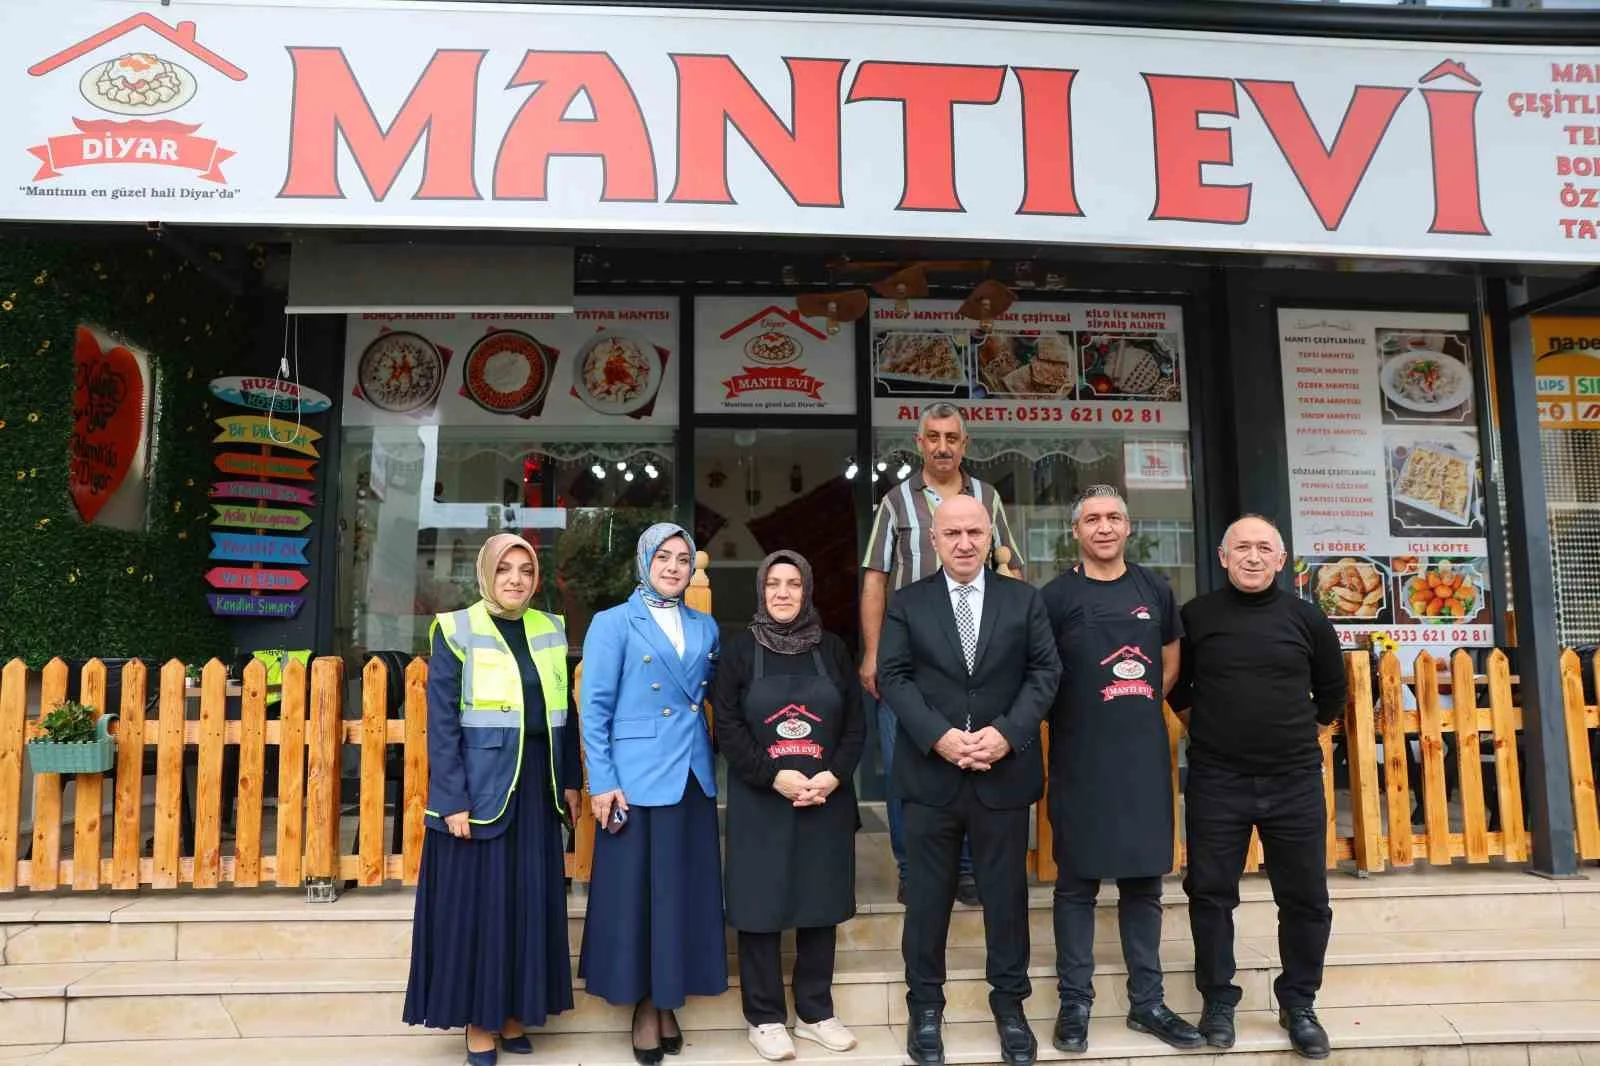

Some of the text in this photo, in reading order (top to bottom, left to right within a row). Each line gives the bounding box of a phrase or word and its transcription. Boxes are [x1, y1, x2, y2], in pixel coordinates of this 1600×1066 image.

[1508, 88, 1600, 118] ÇEŞİTL
[276, 46, 1086, 217] MANTI
[1563, 125, 1600, 145] TE
[82, 131, 180, 161] DİYAR
[91, 188, 107, 197] en
[111, 187, 147, 200] güzel
[150, 188, 175, 198] hali
[1559, 218, 1600, 240] TA
[574, 310, 669, 320] TATAR MANTISI
[1131, 311, 1166, 320] MANTI
[739, 377, 782, 389] MANTI
[1071, 407, 1102, 422] 621
[1111, 408, 1134, 423] 02
[1141, 408, 1161, 424] 81
[1423, 629, 1445, 642] 621
[1451, 629, 1468, 642] 02
[1473, 629, 1488, 642] 81
